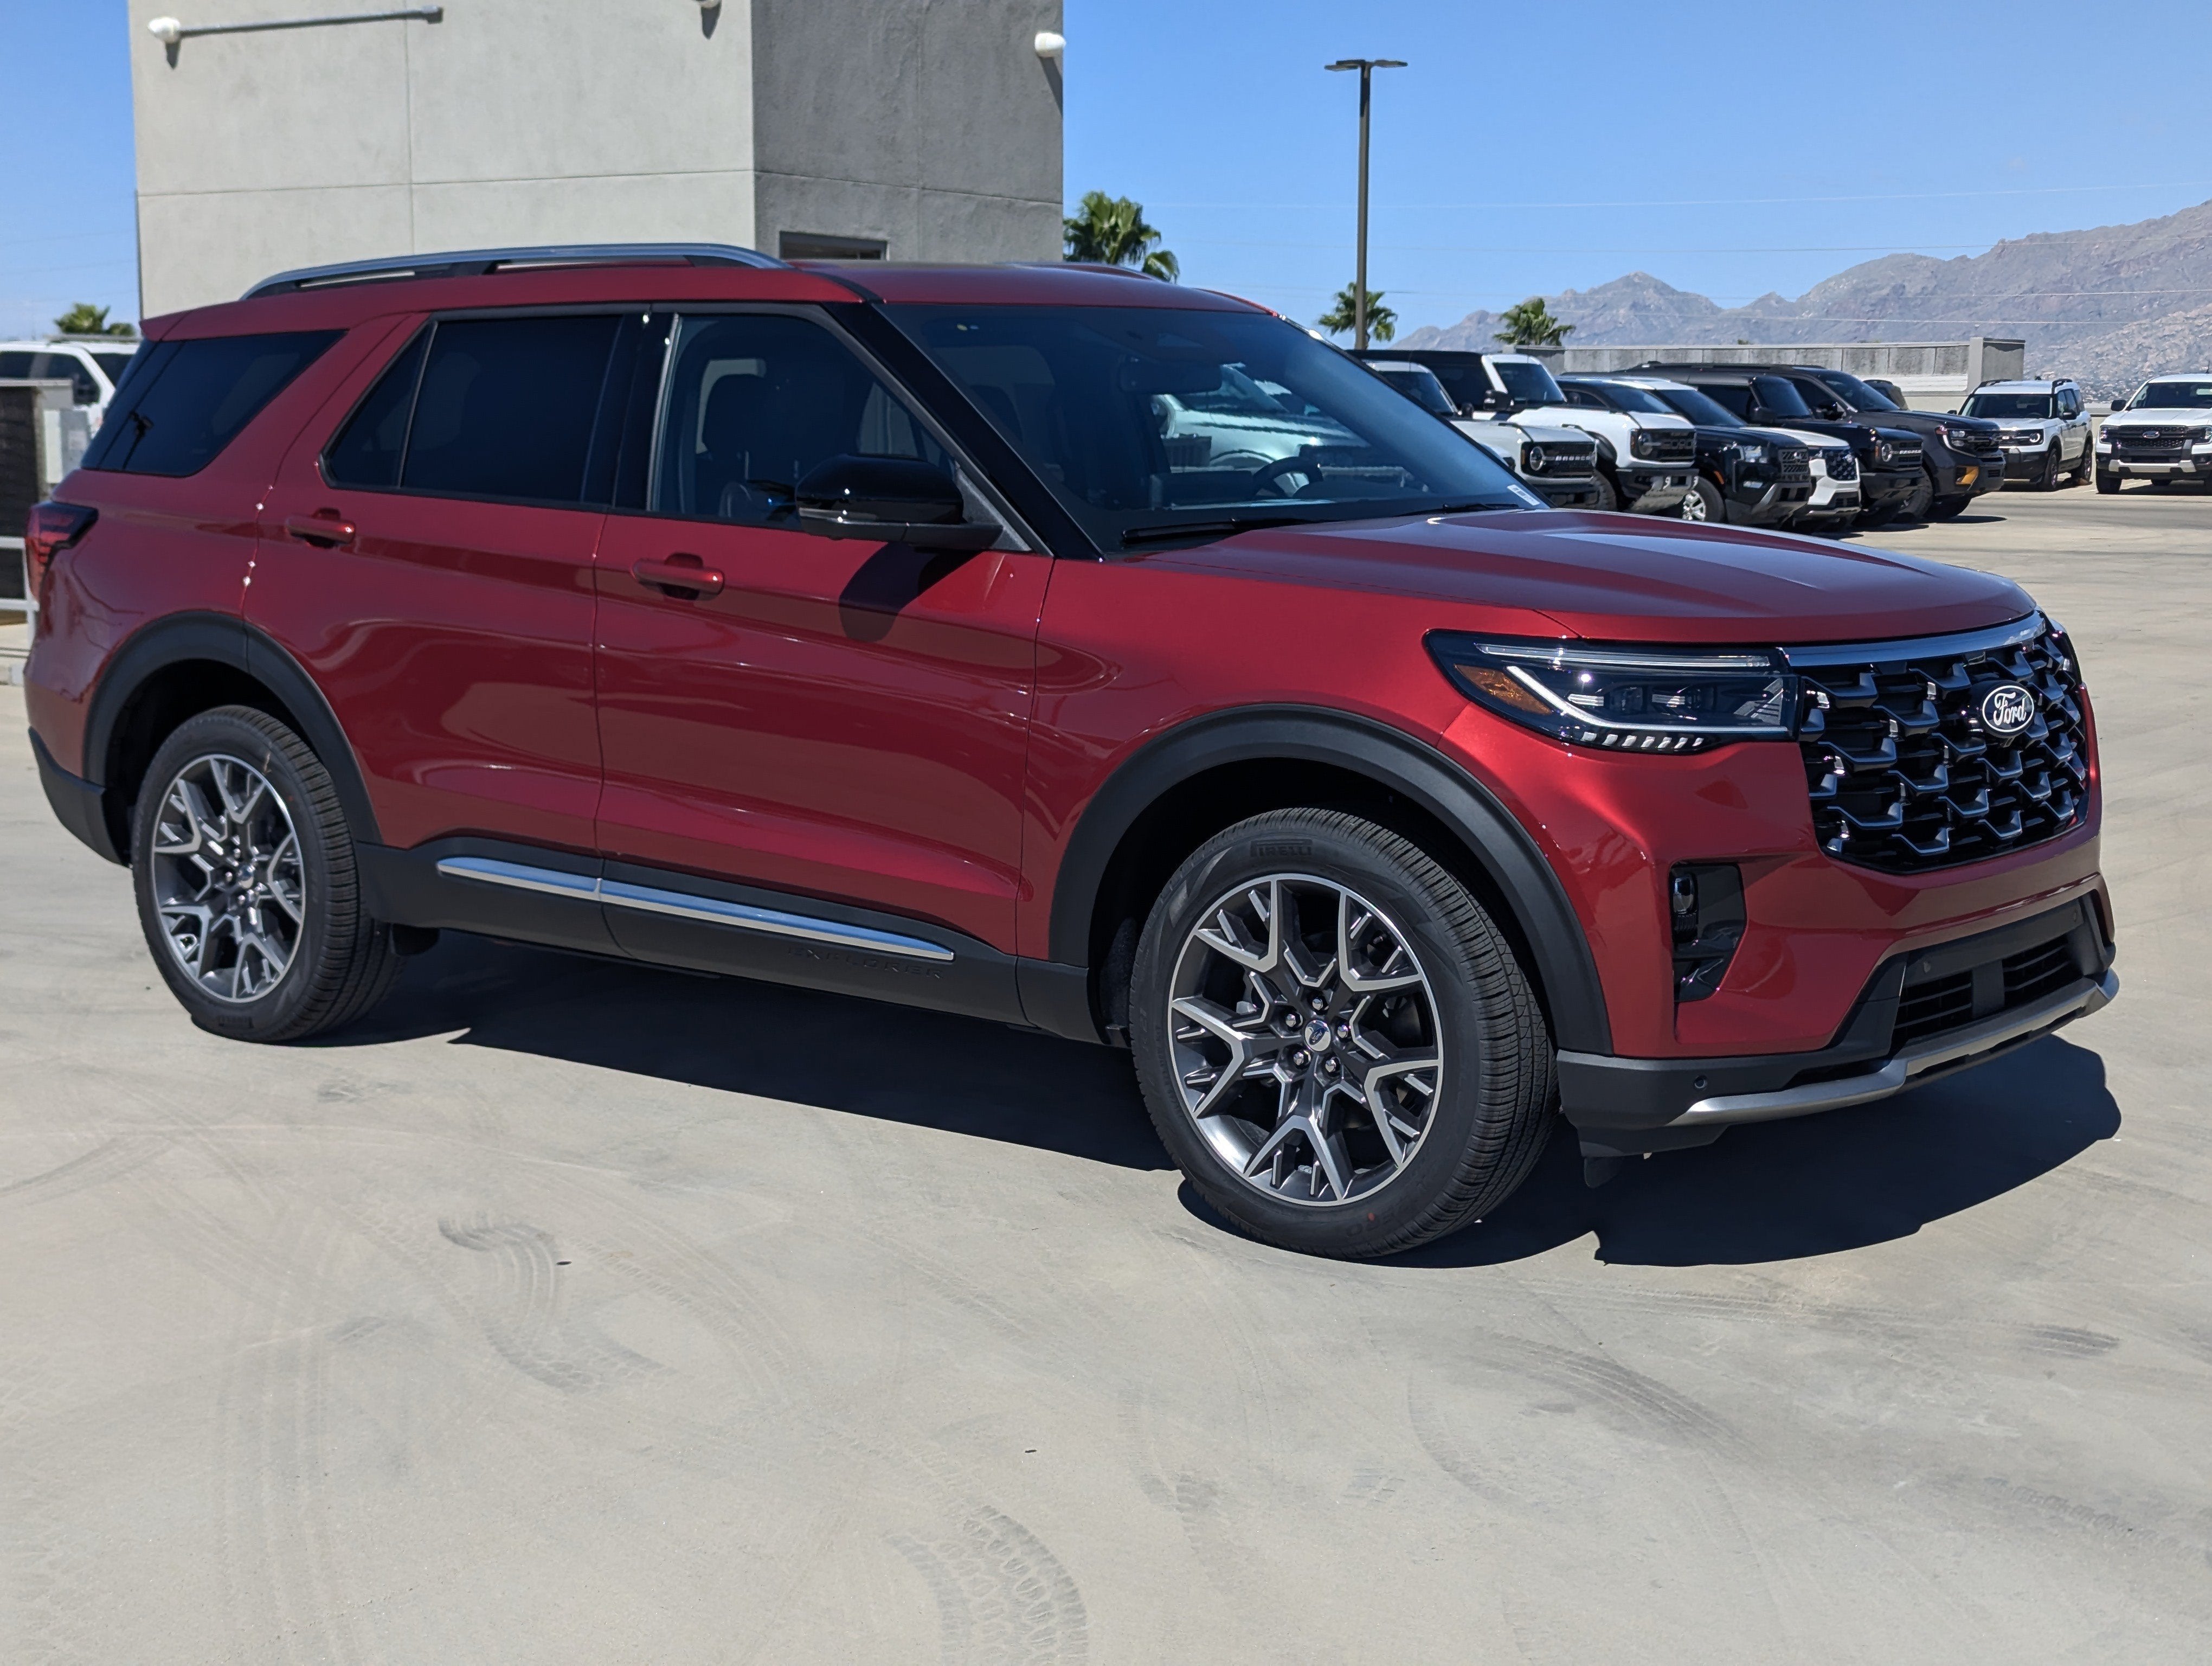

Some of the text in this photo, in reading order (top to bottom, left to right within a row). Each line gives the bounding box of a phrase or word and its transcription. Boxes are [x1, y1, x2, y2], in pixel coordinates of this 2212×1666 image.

[1994, 692, 2026, 726] Ford
[1250, 839, 1313, 857] PIRELLI
[788, 946, 943, 979] EXPLORER
